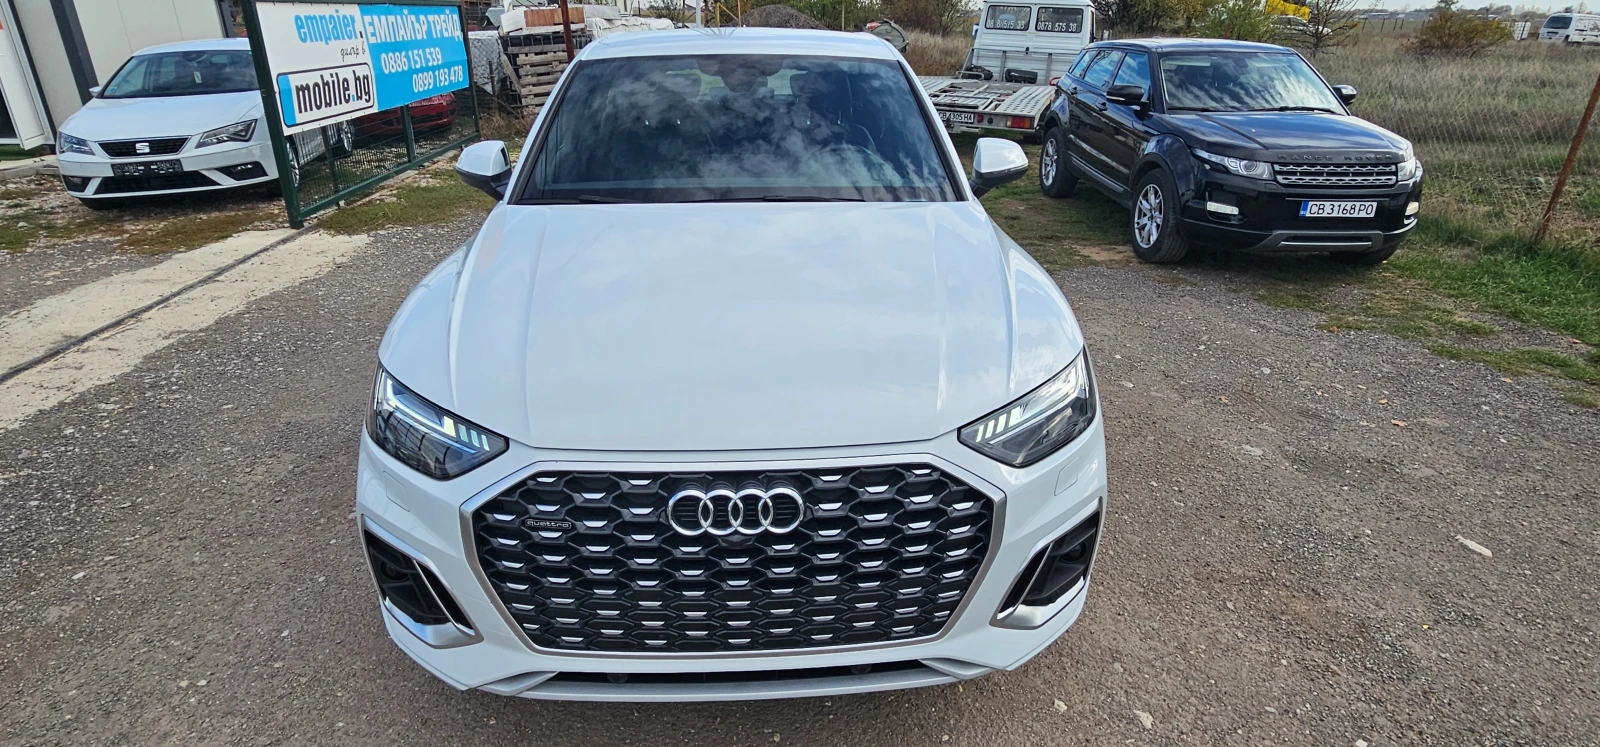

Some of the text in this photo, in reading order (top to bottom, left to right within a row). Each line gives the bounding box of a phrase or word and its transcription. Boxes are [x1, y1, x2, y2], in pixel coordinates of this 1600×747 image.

[363, 9, 464, 43] ЕМПАЙЪР ТРЕЙД
[1054, 22, 1067, 31] 575
[381, 47, 442, 74] 0886 151 539
[412, 65, 463, 93] 0899 193 478
[295, 70, 371, 114] mobile.bg
[1278, 154, 1393, 162] RANGE ROVER
[1309, 204, 1325, 215] CB
[1327, 204, 1356, 215] 3168
[527, 520, 569, 528] quattro
